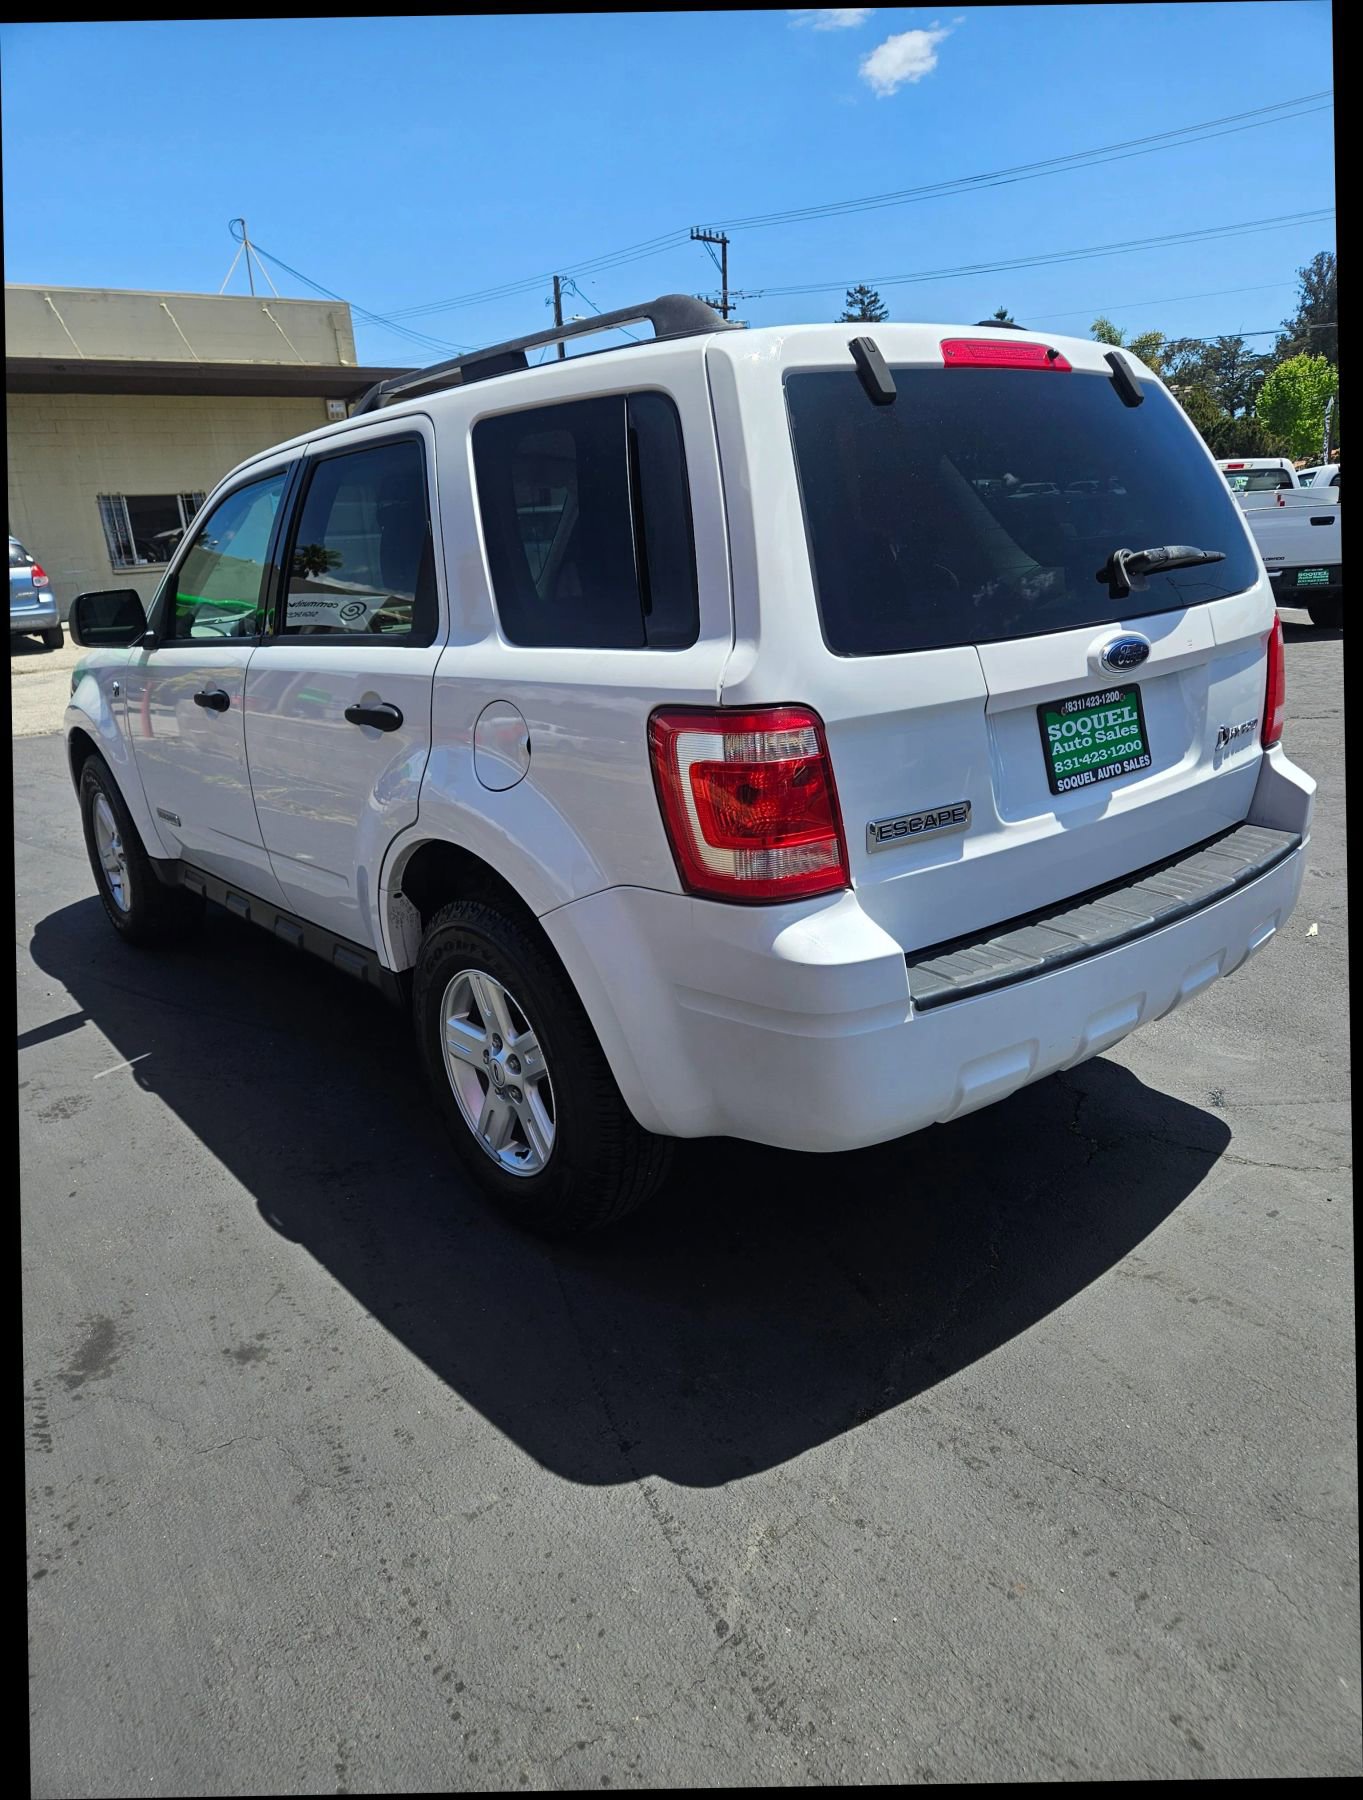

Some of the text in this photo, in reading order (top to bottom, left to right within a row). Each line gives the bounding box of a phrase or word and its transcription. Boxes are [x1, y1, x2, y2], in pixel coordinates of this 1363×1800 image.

[1047, 706, 1138, 742] SOQUEL
[1052, 724, 1138, 756] Auto Sales
[1057, 754, 1150, 792] SOQUEL AUTO SALES
[879, 807, 966, 840] ESCAPE
